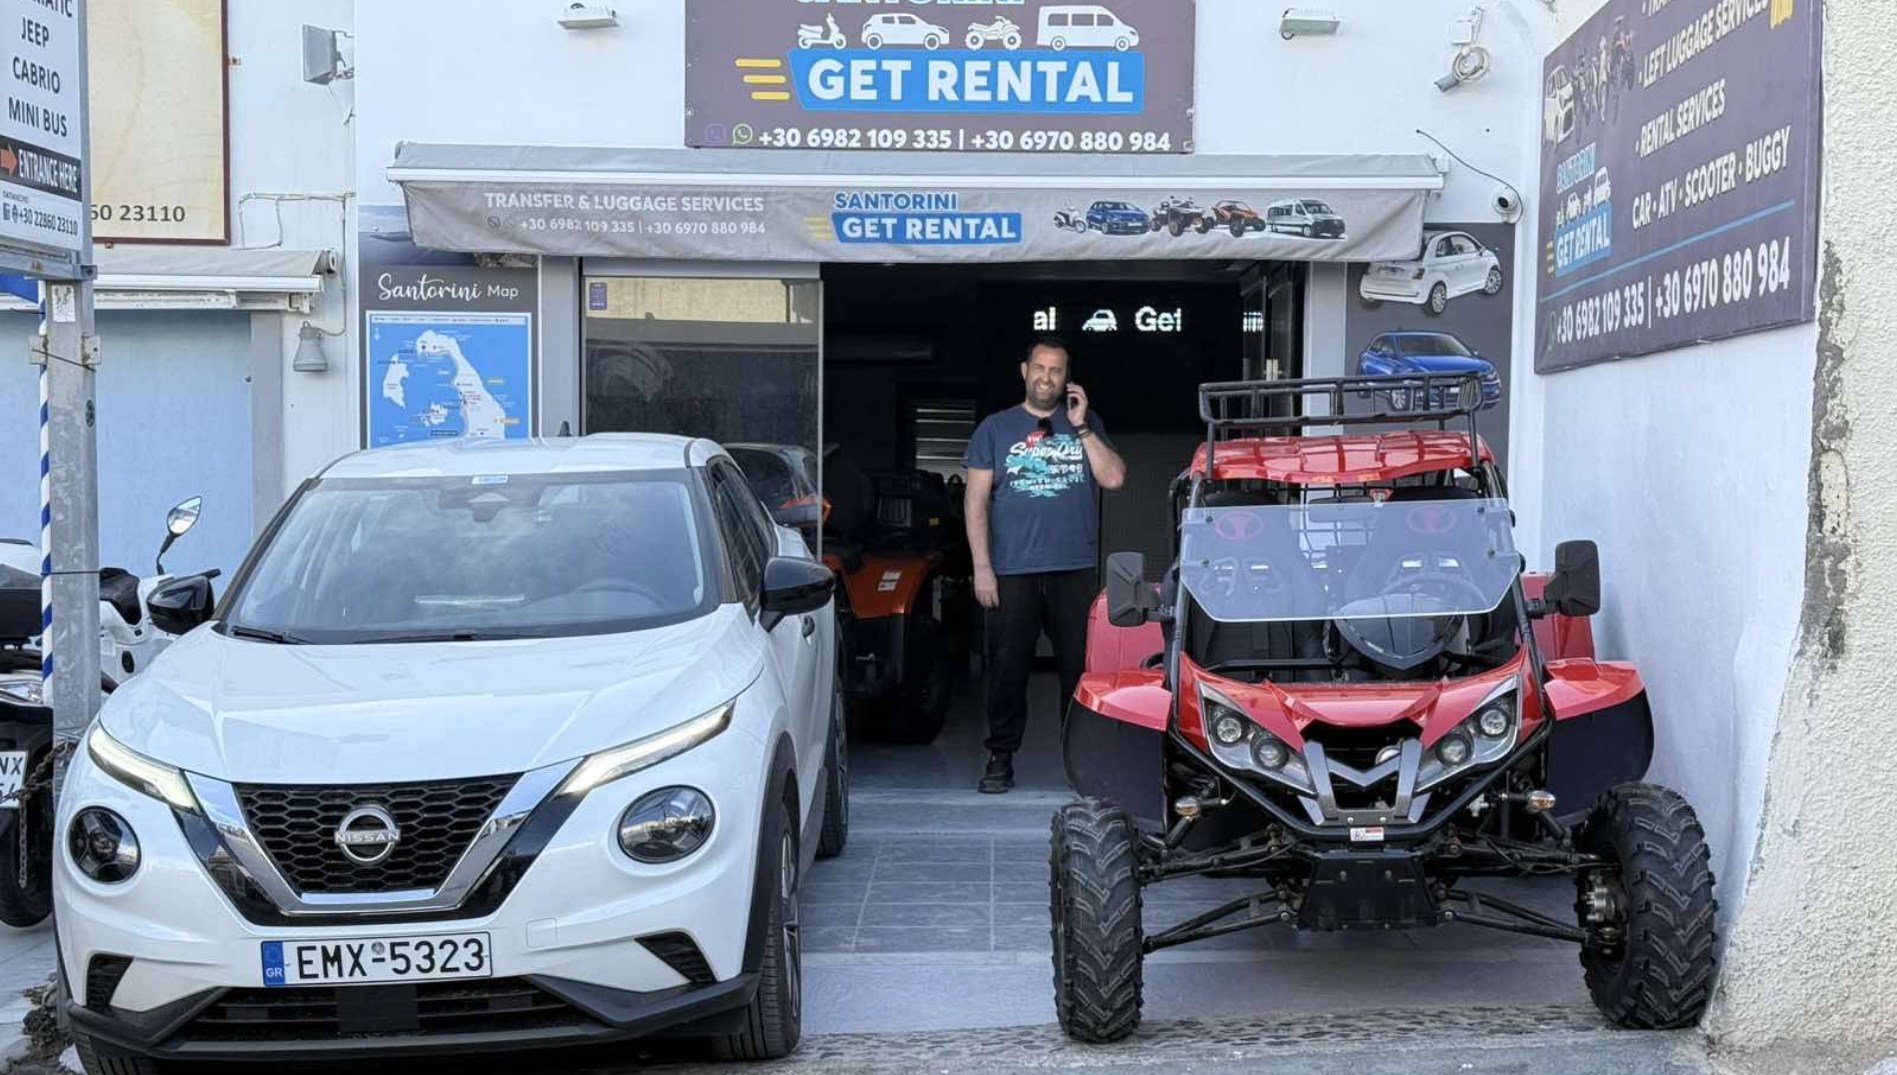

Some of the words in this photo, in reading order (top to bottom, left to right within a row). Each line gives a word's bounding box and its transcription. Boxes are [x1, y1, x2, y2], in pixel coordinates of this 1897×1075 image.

[21, 16, 50, 48] JEEP
[1643, 43, 1668, 88] LEFT
[1666, 8, 1715, 73] LUGGAGE
[12, 55, 61, 94] CABRIO
[807, 58, 911, 102] GET
[927, 60, 1134, 104] RENTAL
[8, 96, 39, 129] MINI
[43, 108, 67, 137] BUS
[1640, 108, 1675, 158] RENTAL
[1676, 78, 1725, 137] SERVICES
[758, 128, 800, 147] +30
[806, 128, 861, 148] 6982
[867, 128, 907, 148] 109
[912, 129, 951, 149] 335
[971, 130, 1013, 150] +30
[1019, 130, 1072, 151] 6970
[1080, 131, 1122, 151] 880
[1129, 131, 1171, 152] 984
[19, 148, 58, 187] ENTRANCE
[59, 160, 78, 193] HERE
[1632, 192, 1651, 229] CAR
[1658, 178, 1678, 219] ATV
[1685, 152, 1737, 207] SCOOTER
[1745, 124, 1791, 183] BUGGY
[19, 207, 33, 225] +30
[120, 205, 186, 222] 23110
[484, 192, 574, 209] TRANSFER
[578, 194, 590, 209] &
[594, 195, 677, 211] LUGGAGE
[681, 196, 764, 212] SERVICES
[834, 192, 958, 212] SANTORINI
[520, 217, 546, 230] +30
[550, 218, 582, 231] 6982
[584, 220, 608, 232] 109
[611, 221, 635, 233] 335
[646, 222, 671, 234] +30
[675, 222, 707, 234] 6970
[711, 222, 737, 234] 880
[740, 222, 766, 234] 984
[842, 217, 900, 240] GET
[905, 217, 1016, 240] RENTAL
[1557, 230, 1575, 269] GET
[1575, 211, 1611, 260] RENTAL
[378, 273, 483, 301] Santorini
[487, 285, 519, 299] Map
[1557, 305, 1574, 344] +30
[1576, 296, 1600, 340] 6982
[1602, 289, 1621, 332] 109
[1624, 281, 1645, 328] 335
[1655, 271, 1680, 319] +30
[1684, 258, 1719, 314] 6970
[1723, 247, 1753, 304] 880
[1757, 236, 1791, 297] 984
[1034, 307, 1056, 331] al
[334, 832, 400, 843] NISSAN
[266, 968, 283, 978] GR
